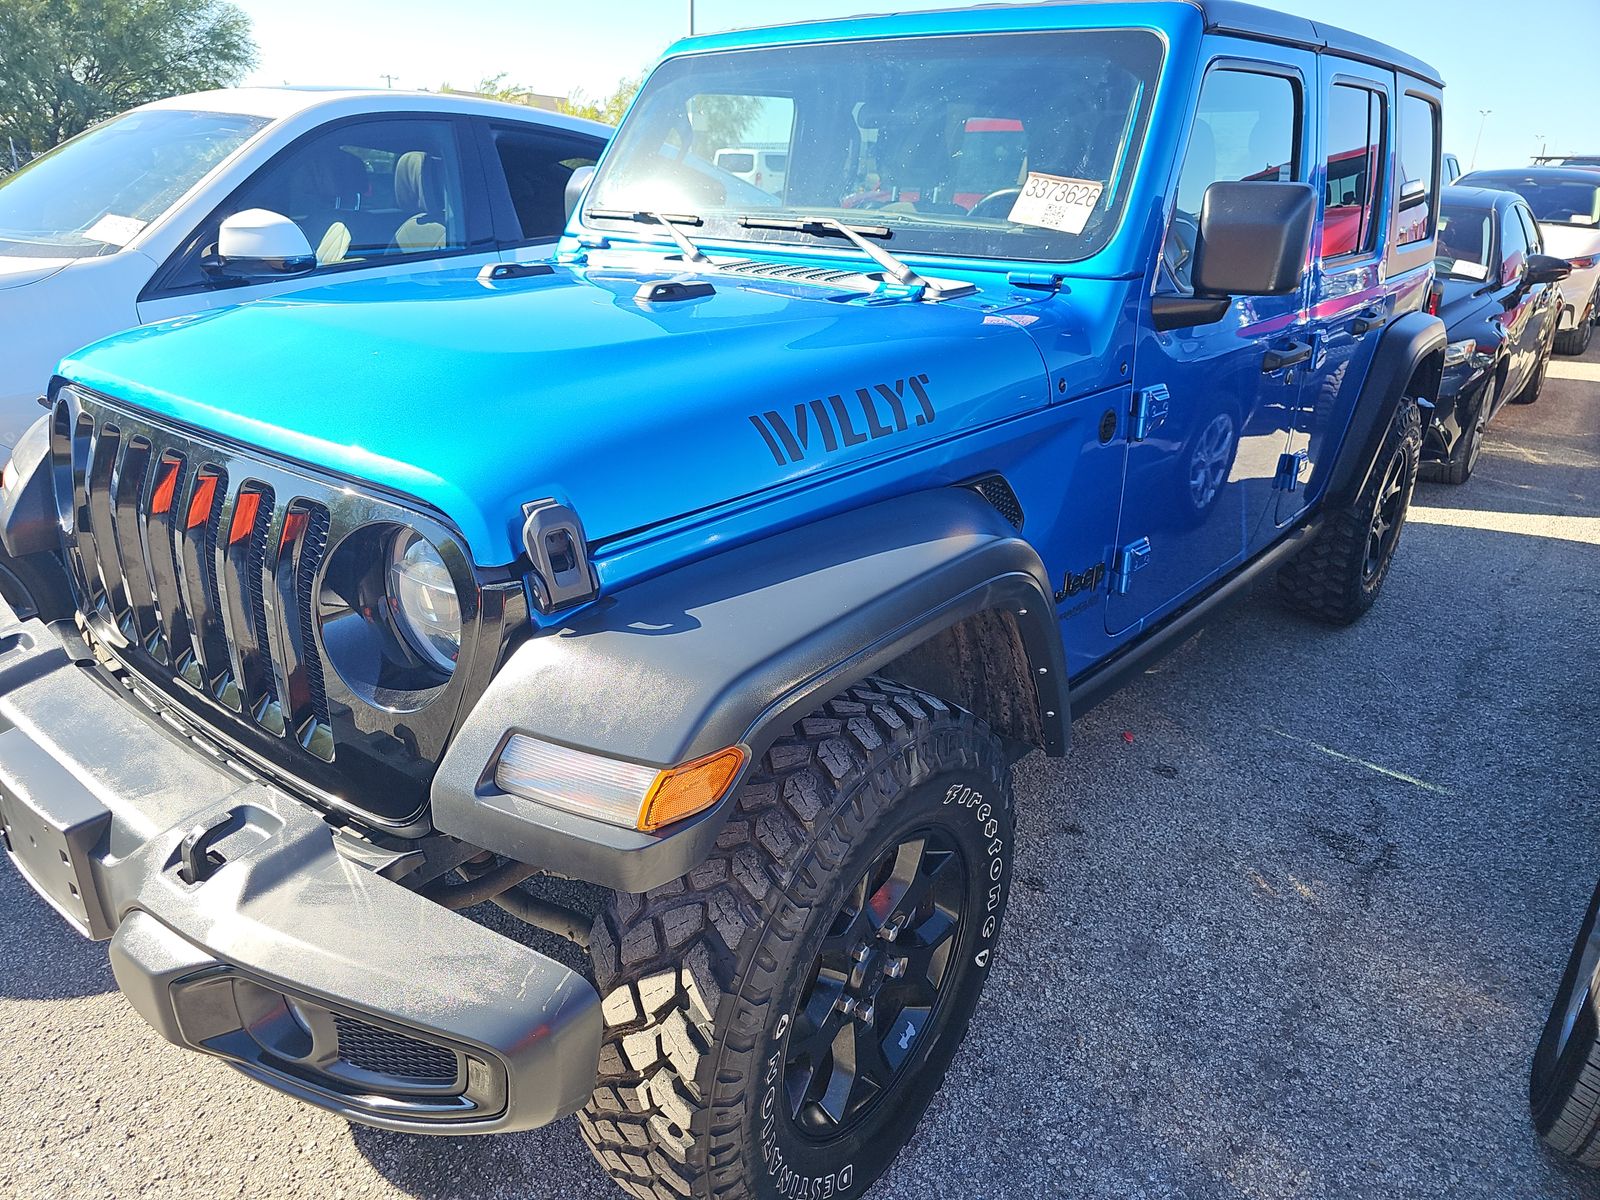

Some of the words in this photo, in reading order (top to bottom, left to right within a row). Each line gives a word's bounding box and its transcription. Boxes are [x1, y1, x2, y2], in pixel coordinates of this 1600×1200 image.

[1025, 178, 1100, 208] 3373626
[748, 373, 936, 467] WILLYS
[1054, 561, 1105, 604] Jeep
[943, 784, 1003, 939] Firestone
[760, 1050, 853, 1200] DESTINATION
